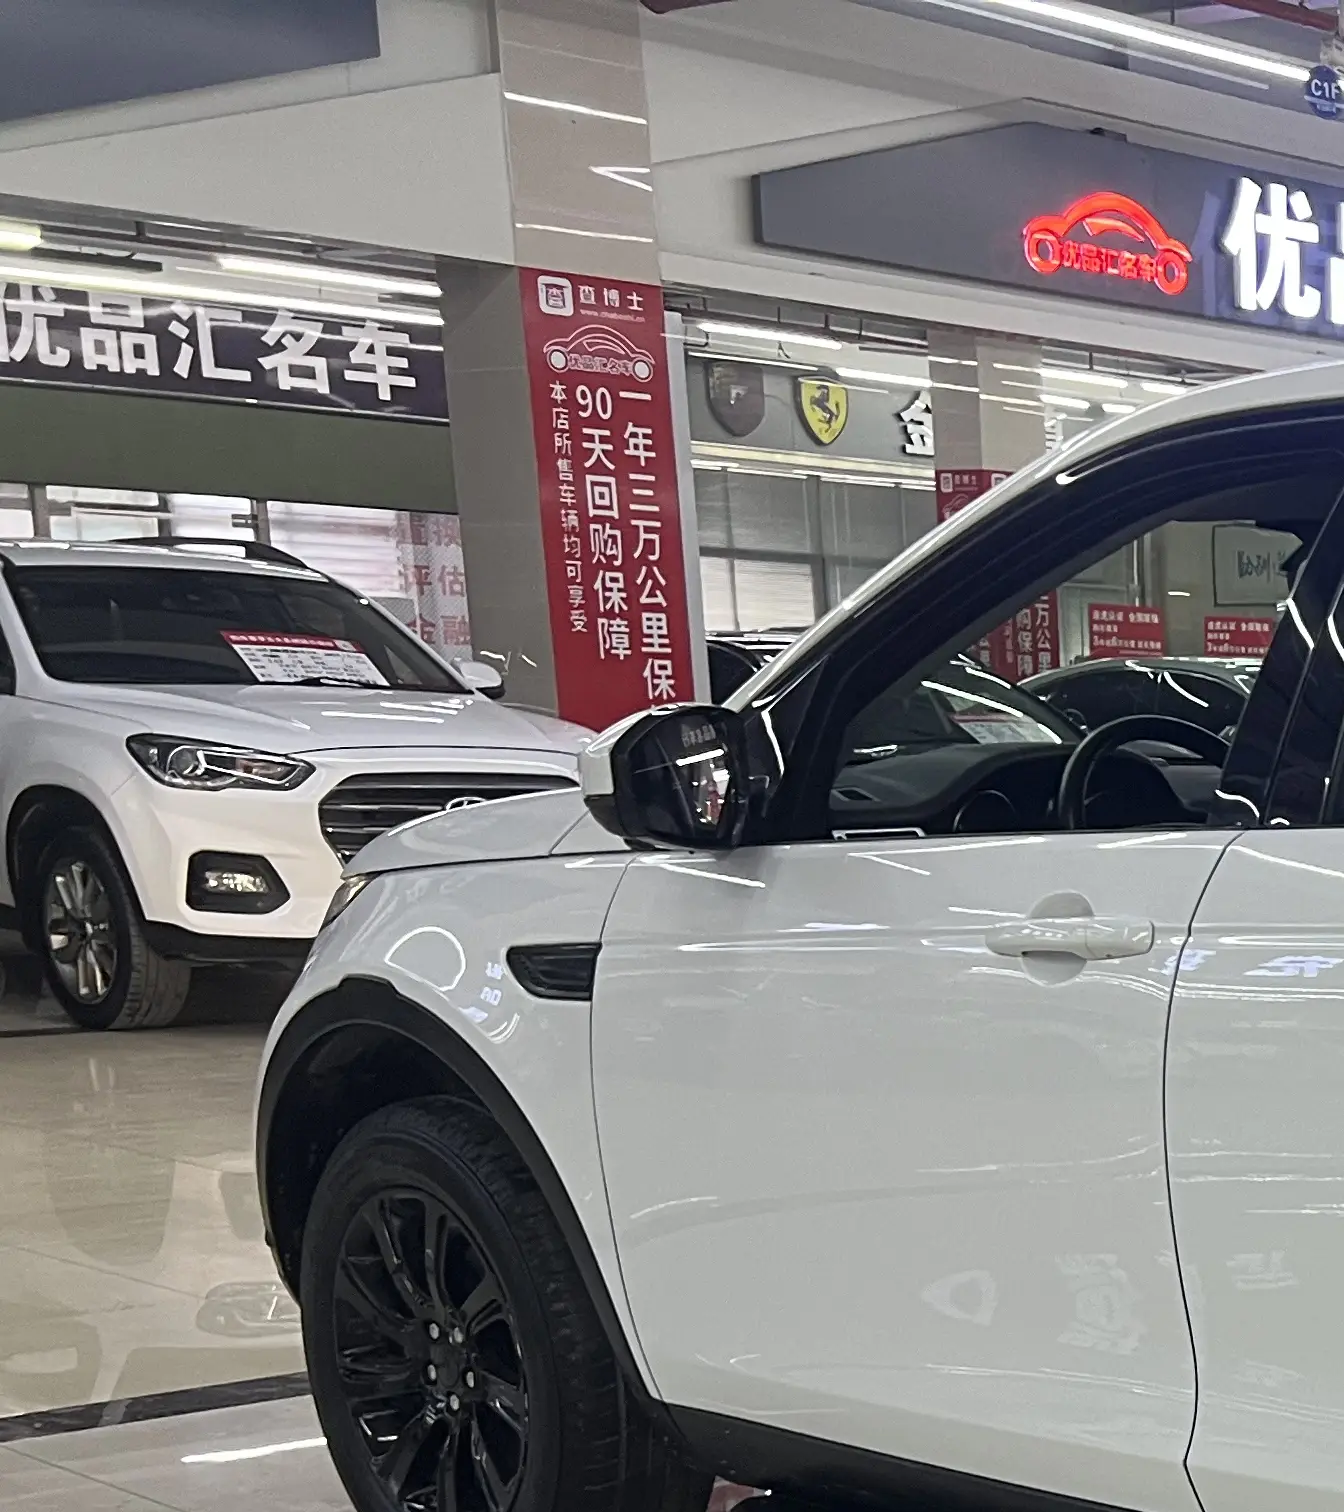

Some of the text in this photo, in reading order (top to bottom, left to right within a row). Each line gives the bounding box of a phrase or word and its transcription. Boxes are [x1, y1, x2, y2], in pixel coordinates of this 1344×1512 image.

[577, 285, 644, 311] 查博士
[1062, 240, 1157, 282] 优品汇名车
[0, 281, 417, 401] 优品汇名车
[549, 380, 588, 633] 本店所售车辆均可享受
[575, 385, 632, 661] 90天回购保障
[619, 391, 677, 706] 一年三万公里保
[1034, 596, 1052, 672] 万公里
